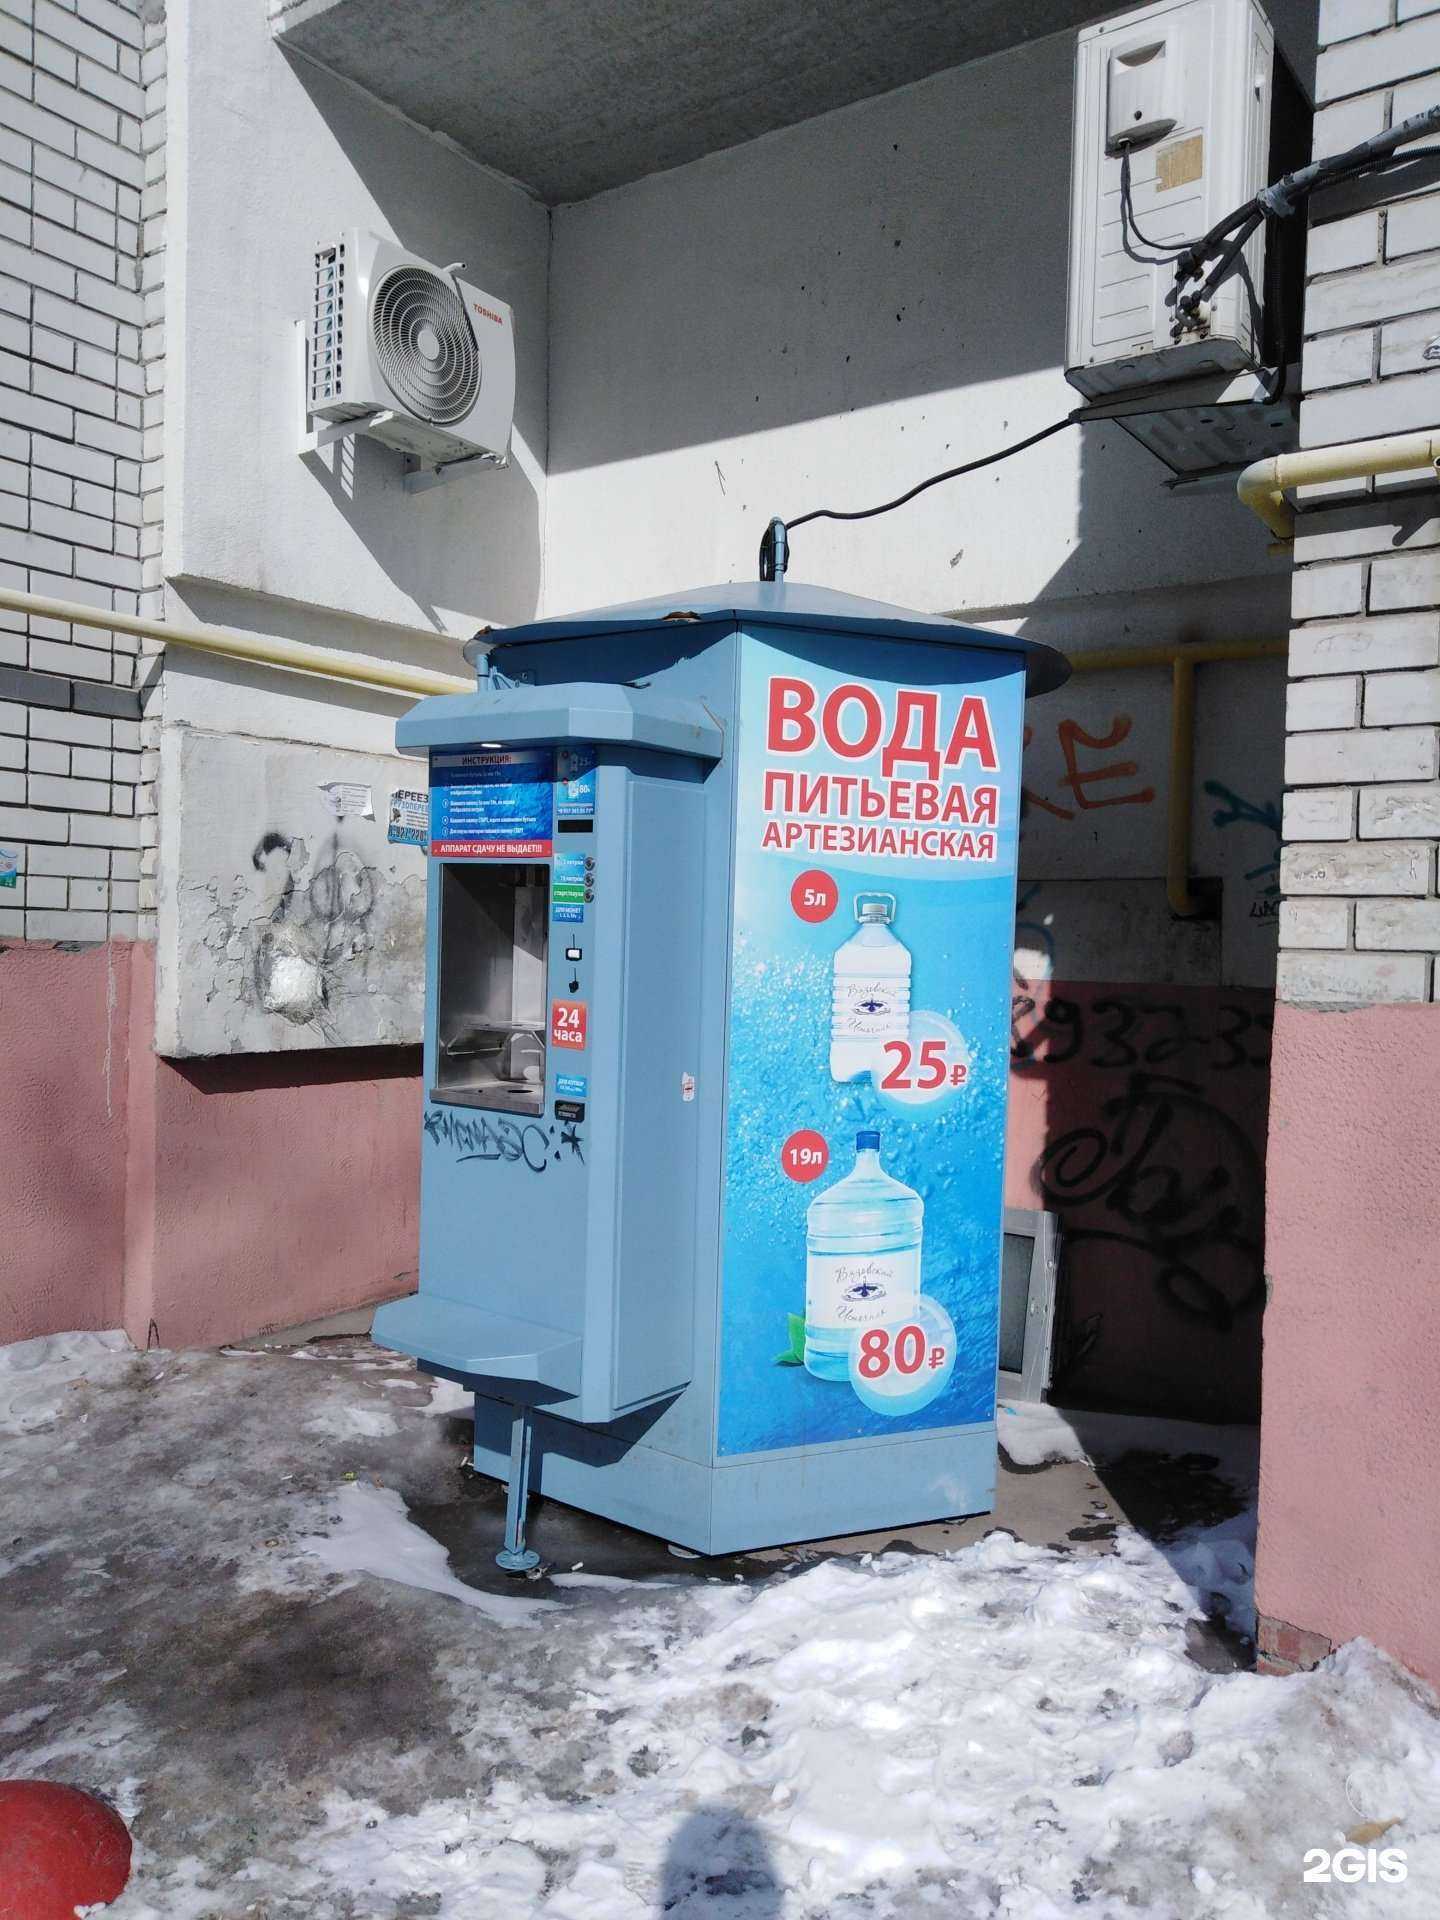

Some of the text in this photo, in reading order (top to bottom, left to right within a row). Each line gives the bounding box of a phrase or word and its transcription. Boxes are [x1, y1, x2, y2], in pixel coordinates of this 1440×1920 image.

[473, 303, 503, 325] TOSHIBA
[767, 677, 997, 781] ВОДА
[764, 771, 997, 824] ПИТЬЕВАЯ
[440, 844, 542, 854] АППАРАТ СДАЧУ НЕ ВЫДАЕТ!!!
[761, 821, 995, 859] АРТЕЗИАНСКАЯ
[803, 889, 827, 906] 5л
[557, 1007, 580, 1029] 24
[554, 1029, 583, 1043] часа
[790, 1148, 823, 1165] 19л
